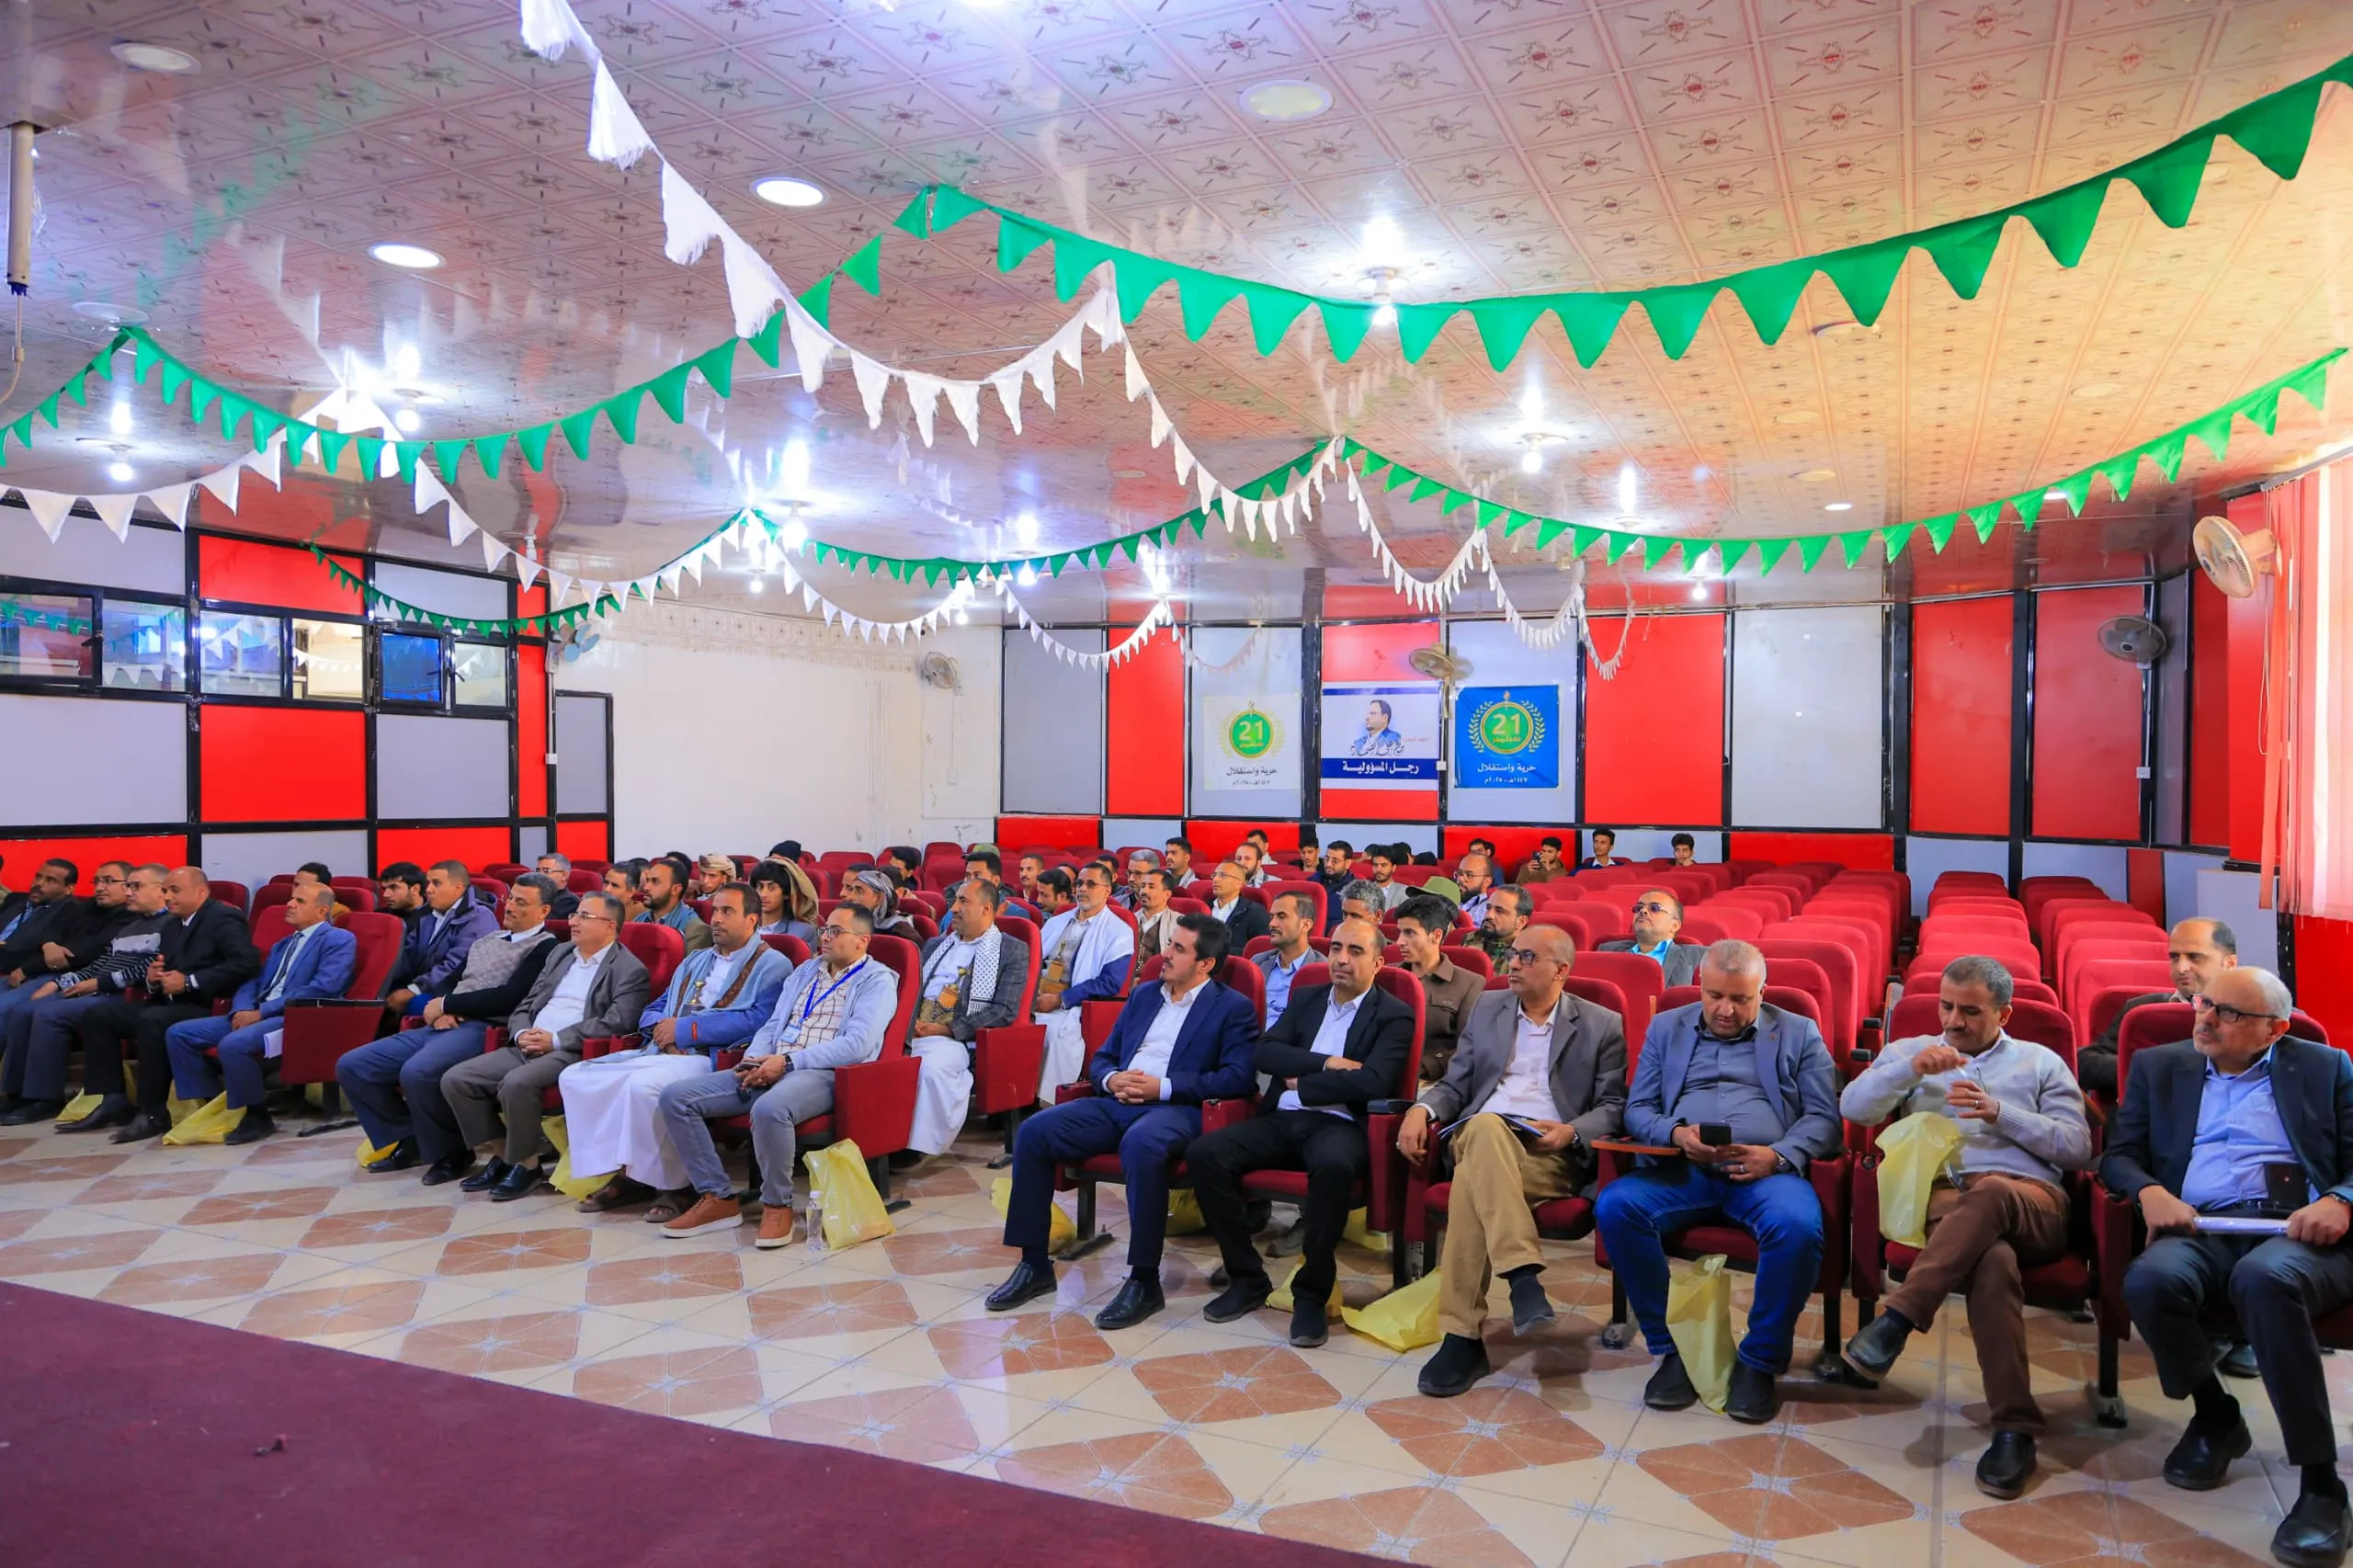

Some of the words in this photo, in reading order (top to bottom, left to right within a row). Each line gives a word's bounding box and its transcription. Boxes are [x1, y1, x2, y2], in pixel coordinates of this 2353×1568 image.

[1492, 713, 1521, 735] 21
[1239, 721, 1264, 741] 21
[1226, 766, 1259, 776] واستقلال
[1260, 766, 1278, 776] حرية
[1342, 760, 1388, 774] المسؤولية
[1389, 761, 1419, 774] رجل
[1478, 763, 1515, 773] واستقلال
[1518, 763, 1536, 773] حرية
